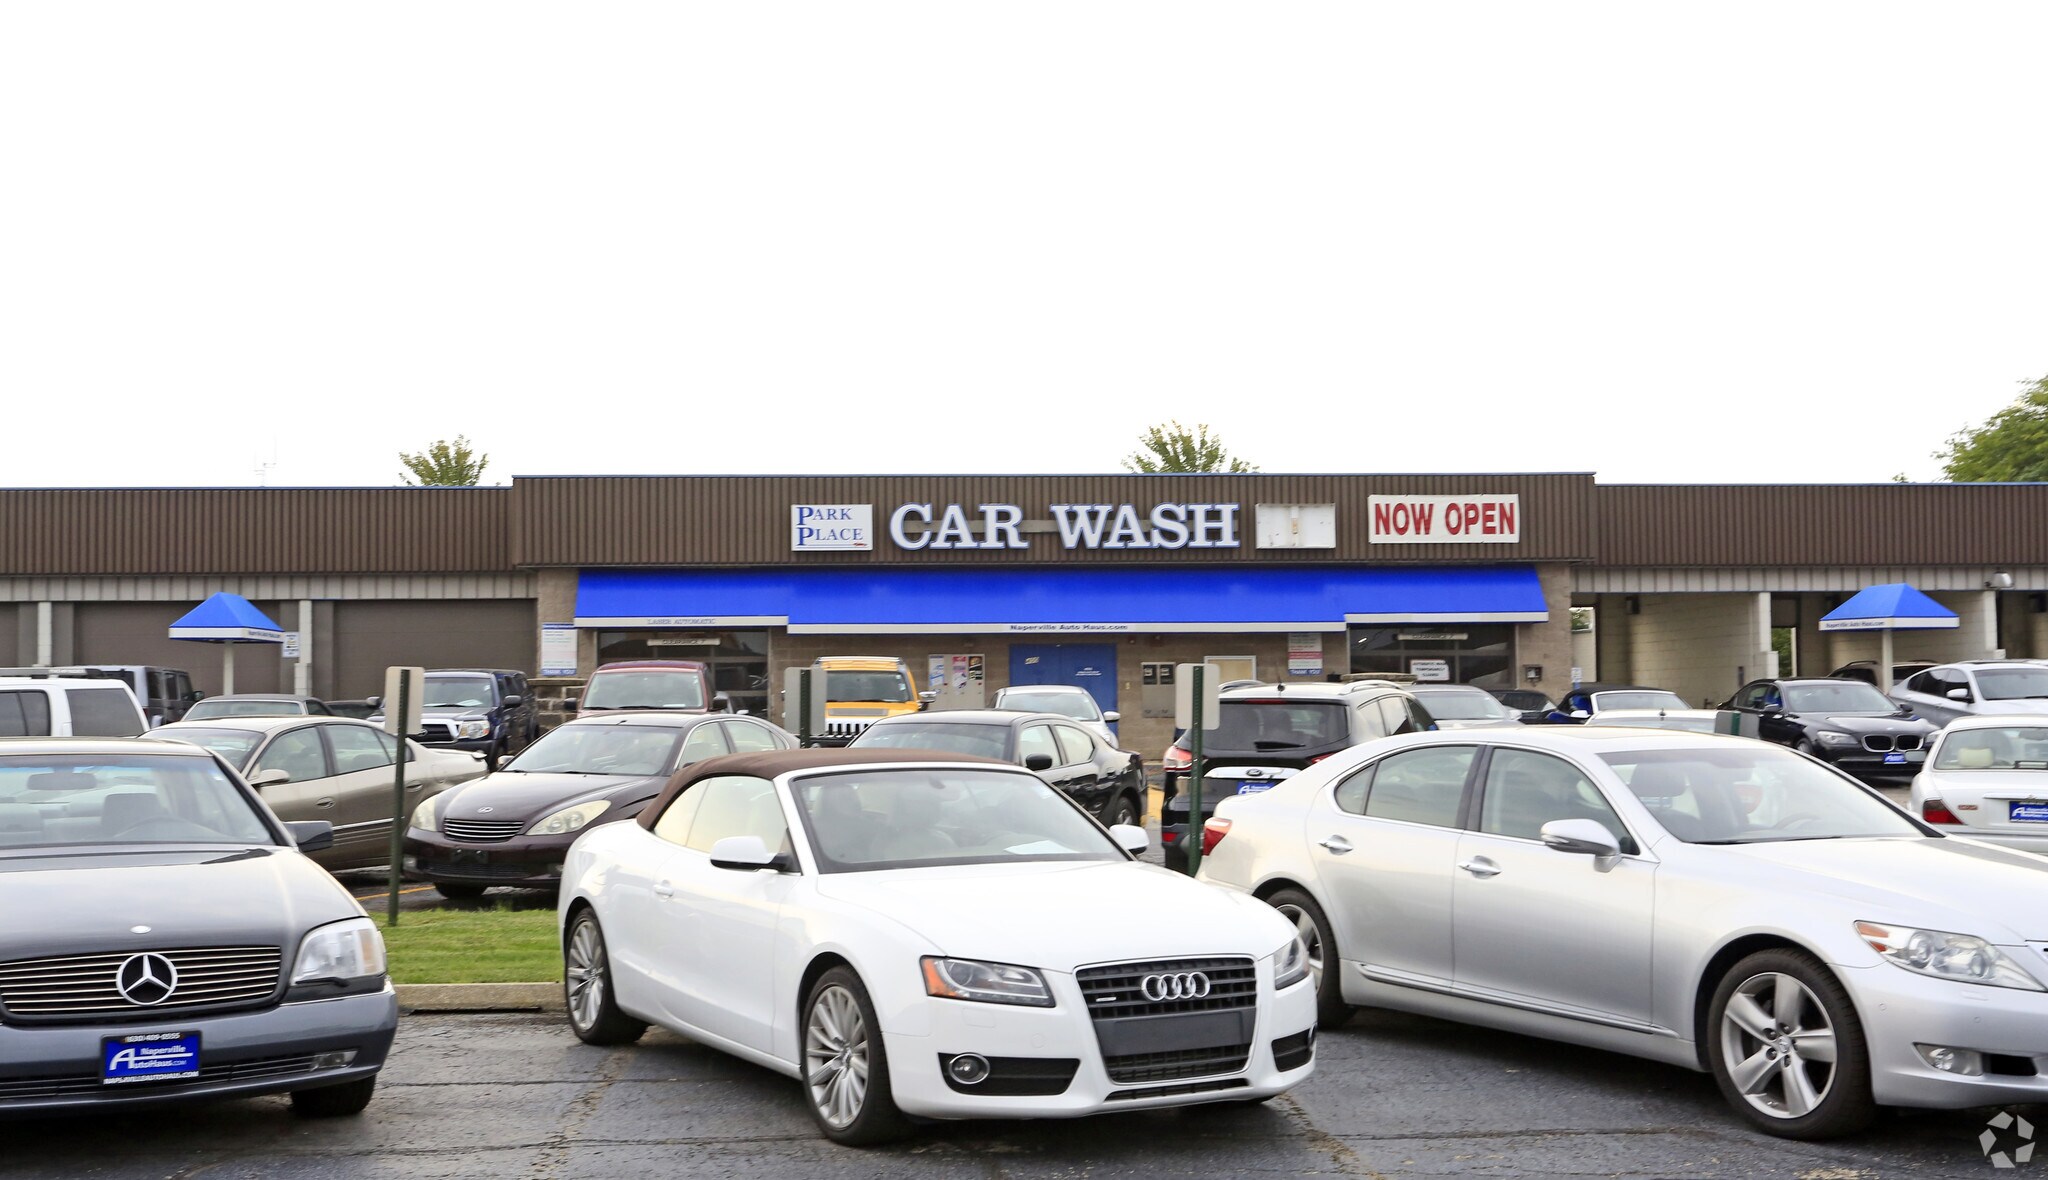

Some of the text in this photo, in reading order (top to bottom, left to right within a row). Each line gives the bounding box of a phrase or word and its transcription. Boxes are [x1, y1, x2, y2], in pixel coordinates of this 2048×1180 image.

[796, 506, 853, 526] PARK
[1374, 502, 1515, 536] NOW OPEN
[796, 526, 864, 546] PLACE
[889, 502, 1241, 551] CAR WASH
[140, 1044, 187, 1056] Naperville
